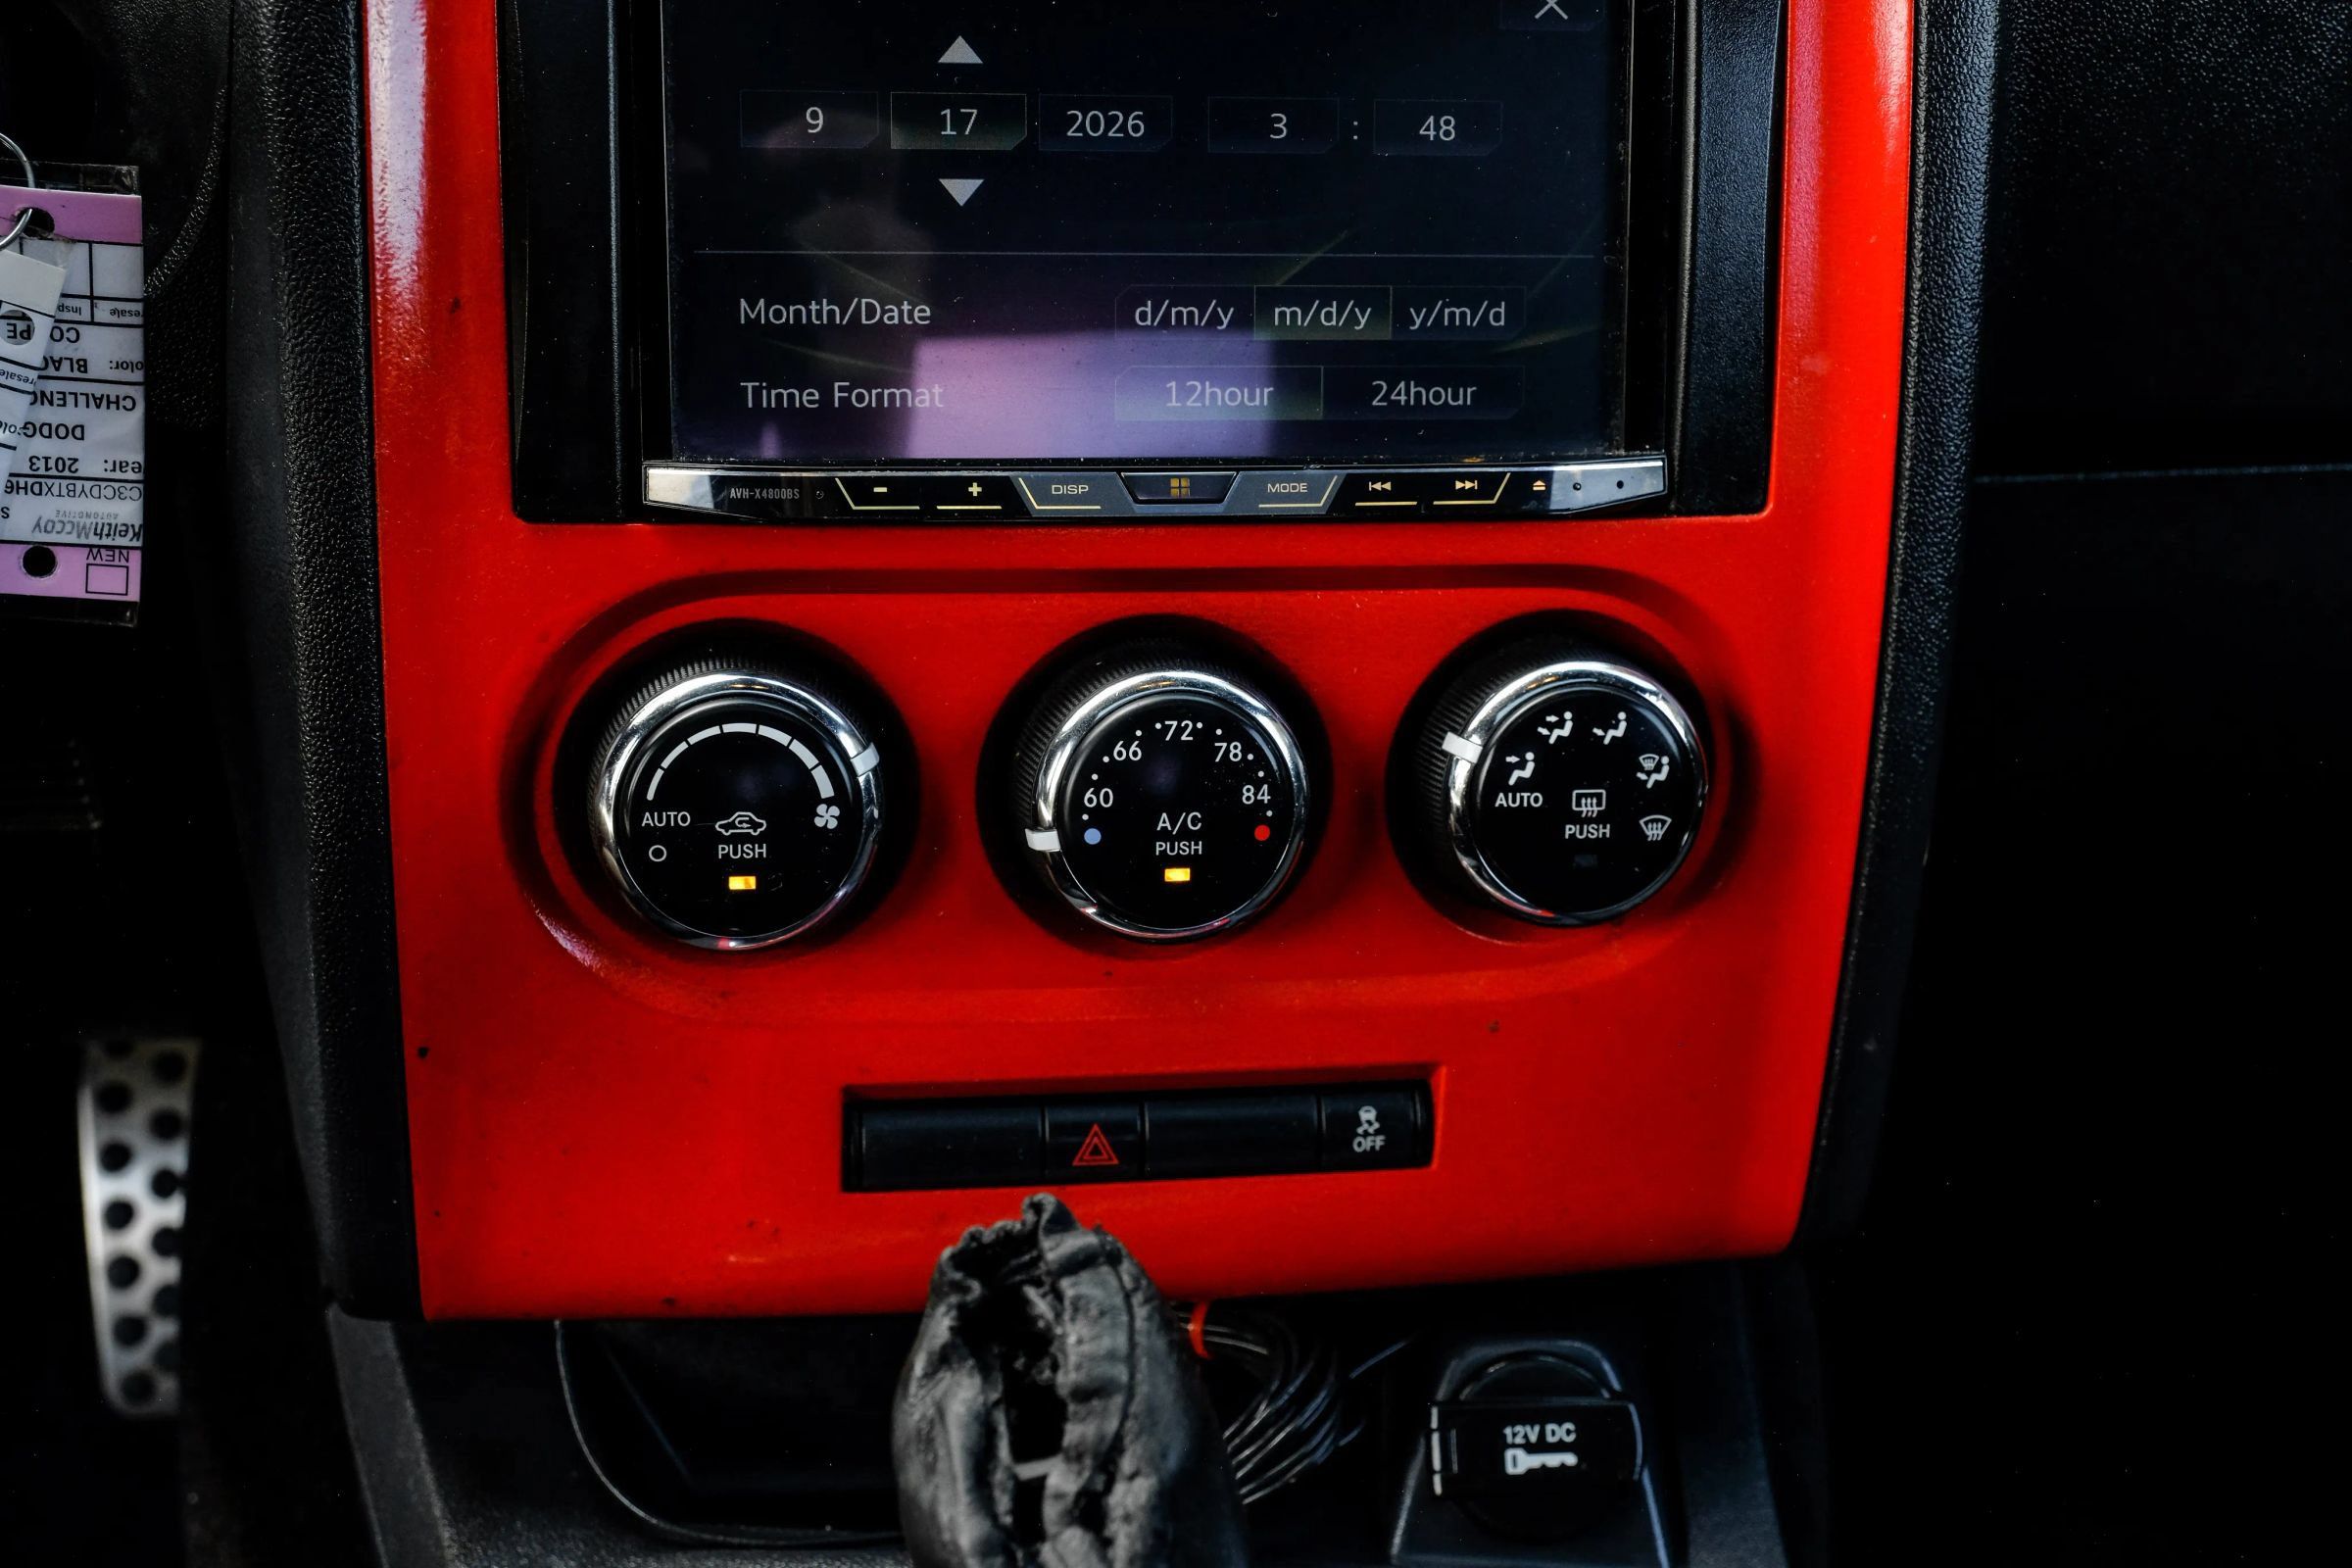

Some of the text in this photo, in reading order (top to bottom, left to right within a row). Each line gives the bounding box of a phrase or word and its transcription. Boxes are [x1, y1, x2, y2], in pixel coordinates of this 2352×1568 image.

[806, 106, 1146, 137] 9 17 2026
[1269, 113, 1288, 139] 3
[1419, 115, 1456, 141] 48
[110, 308, 144, 318] esale
[740, 297, 932, 326] Month/Date
[1134, 300, 1235, 330] d/m/y
[1273, 300, 1372, 330] m/d/y
[1409, 300, 1506, 330] y/m/d
[109, 359, 145, 372] olor:
[0, 368, 36, 386] resale
[740, 381, 944, 409] Time Format
[1164, 380, 1274, 408] 12hour
[1370, 380, 1478, 407] 24hour
[28, 455, 79, 473] 2013
[104, 459, 143, 474] ear:
[1052, 484, 1090, 495] DISP
[1267, 482, 1308, 493] MODE
[85, 547, 130, 564] NEW
[1164, 719, 1194, 741] 72
[1112, 740, 1143, 761] 66
[1214, 741, 1244, 762] 78
[1083, 787, 1114, 808] 60
[1242, 783, 1272, 805] 84
[1494, 792, 1544, 808] AUTO
[641, 810, 691, 827] AUTO
[1156, 811, 1203, 835] A/C
[1564, 823, 1611, 839] PUSH
[717, 843, 767, 859] PUSH
[1155, 840, 1203, 856] PUSH
[1352, 1135, 1386, 1153] OFF
[1502, 1422, 1577, 1445] 12V DC
